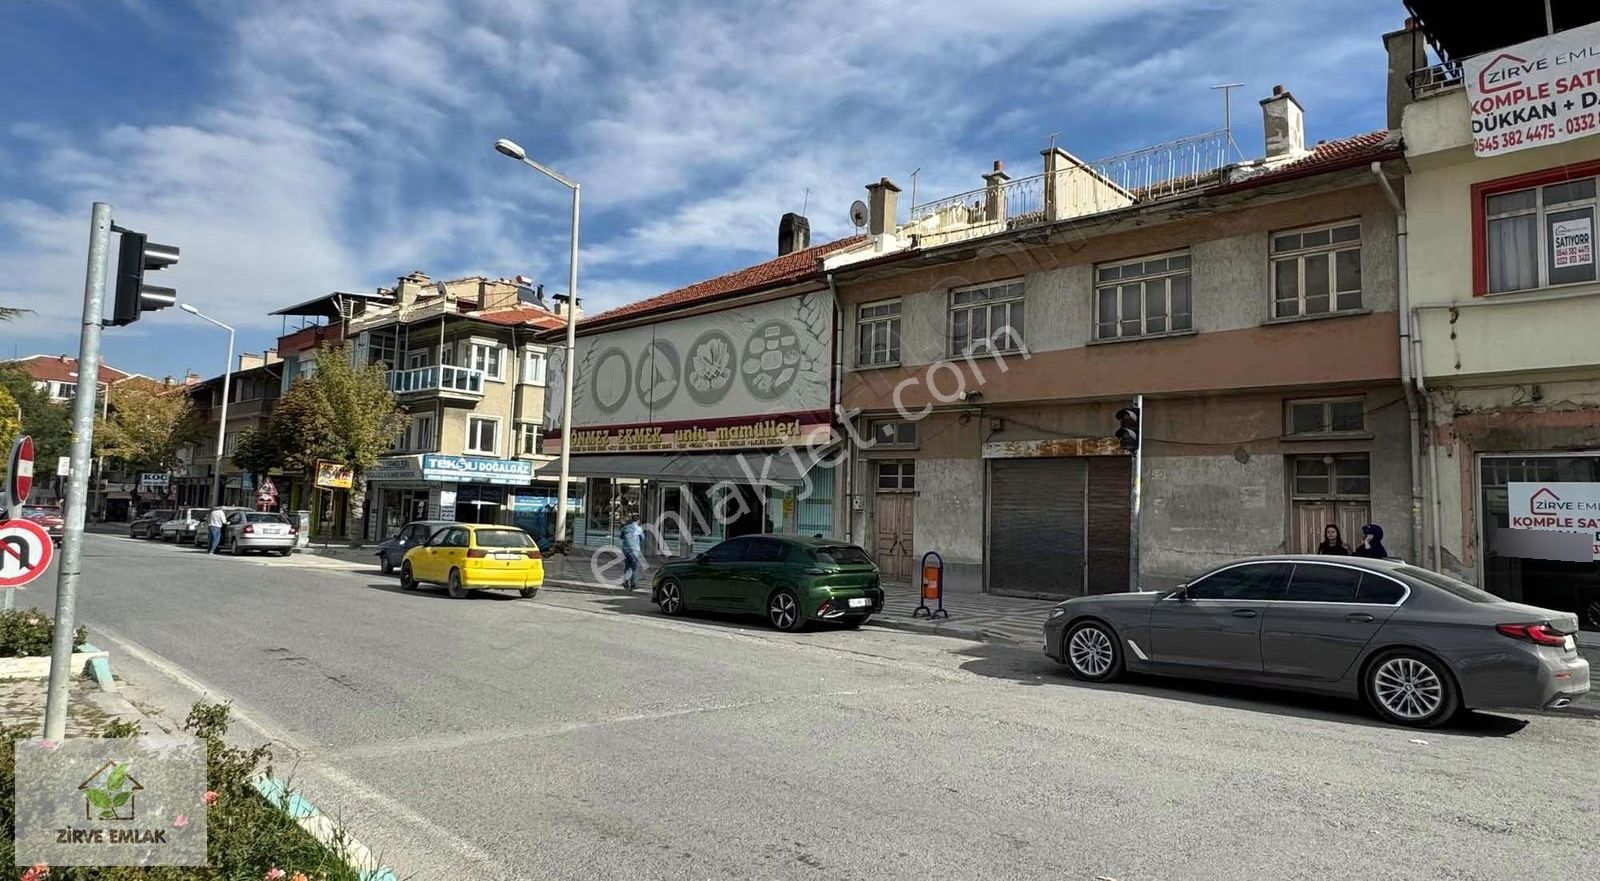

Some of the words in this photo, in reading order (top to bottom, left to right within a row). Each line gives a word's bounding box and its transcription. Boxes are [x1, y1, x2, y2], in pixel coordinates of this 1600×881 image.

[1488, 58, 1548, 84] ZİRVE
[1471, 83, 1550, 115] KOMPLE
[1472, 101, 1557, 133] DÜKKAN
[1581, 92, 1600, 109] D
[1474, 135, 1499, 152] 0545
[1502, 130, 1523, 148] 382
[1526, 123, 1555, 142] 4475
[1566, 113, 1595, 134] 0332
[1556, 234, 1589, 248] SATIYORR
[570, 428, 609, 446] ÖNMEZ
[618, 427, 662, 444] EKMEK
[675, 426, 708, 442] unlu
[1536, 500, 1573, 510] ZİRVE
[1577, 502, 1600, 510] EM
[1513, 517, 1573, 528] KOMPLE
